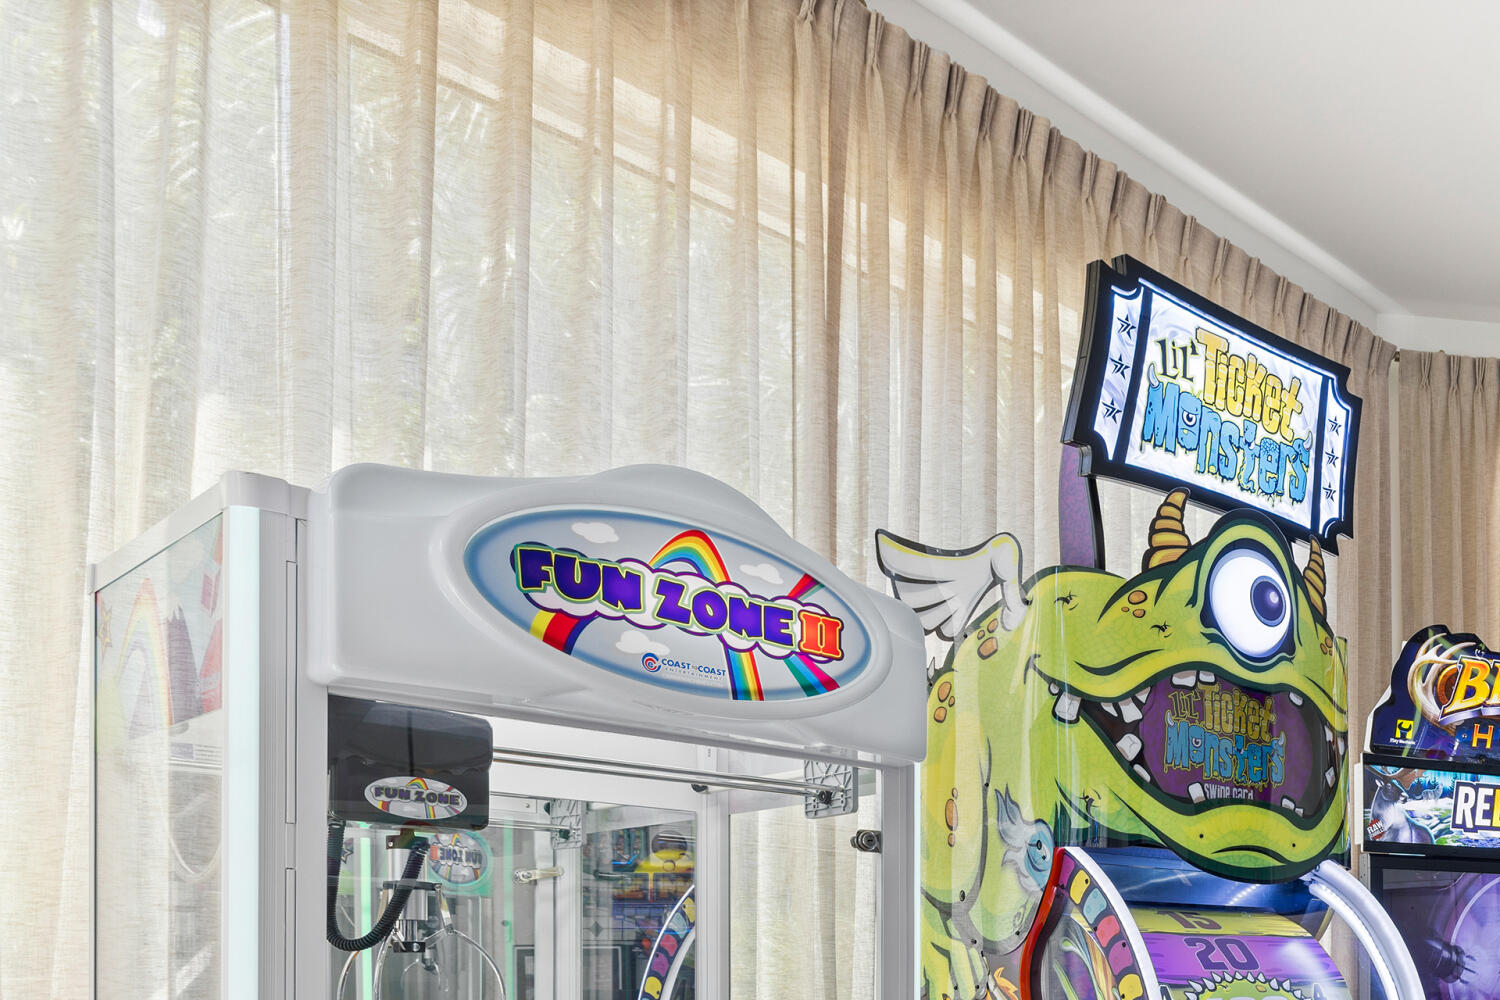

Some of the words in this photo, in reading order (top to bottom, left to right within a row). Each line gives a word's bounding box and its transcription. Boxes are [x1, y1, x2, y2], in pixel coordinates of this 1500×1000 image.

[514, 543, 645, 612] FUN
[653, 577, 796, 647] ZONE
[798, 609, 844, 660] II
[662, 658, 691, 670] COAST
[697, 666, 726, 676] COAST
[374, 786, 411, 800] FUN
[414, 789, 461, 806] ZONE
[1184, 936, 1260, 972] 20
